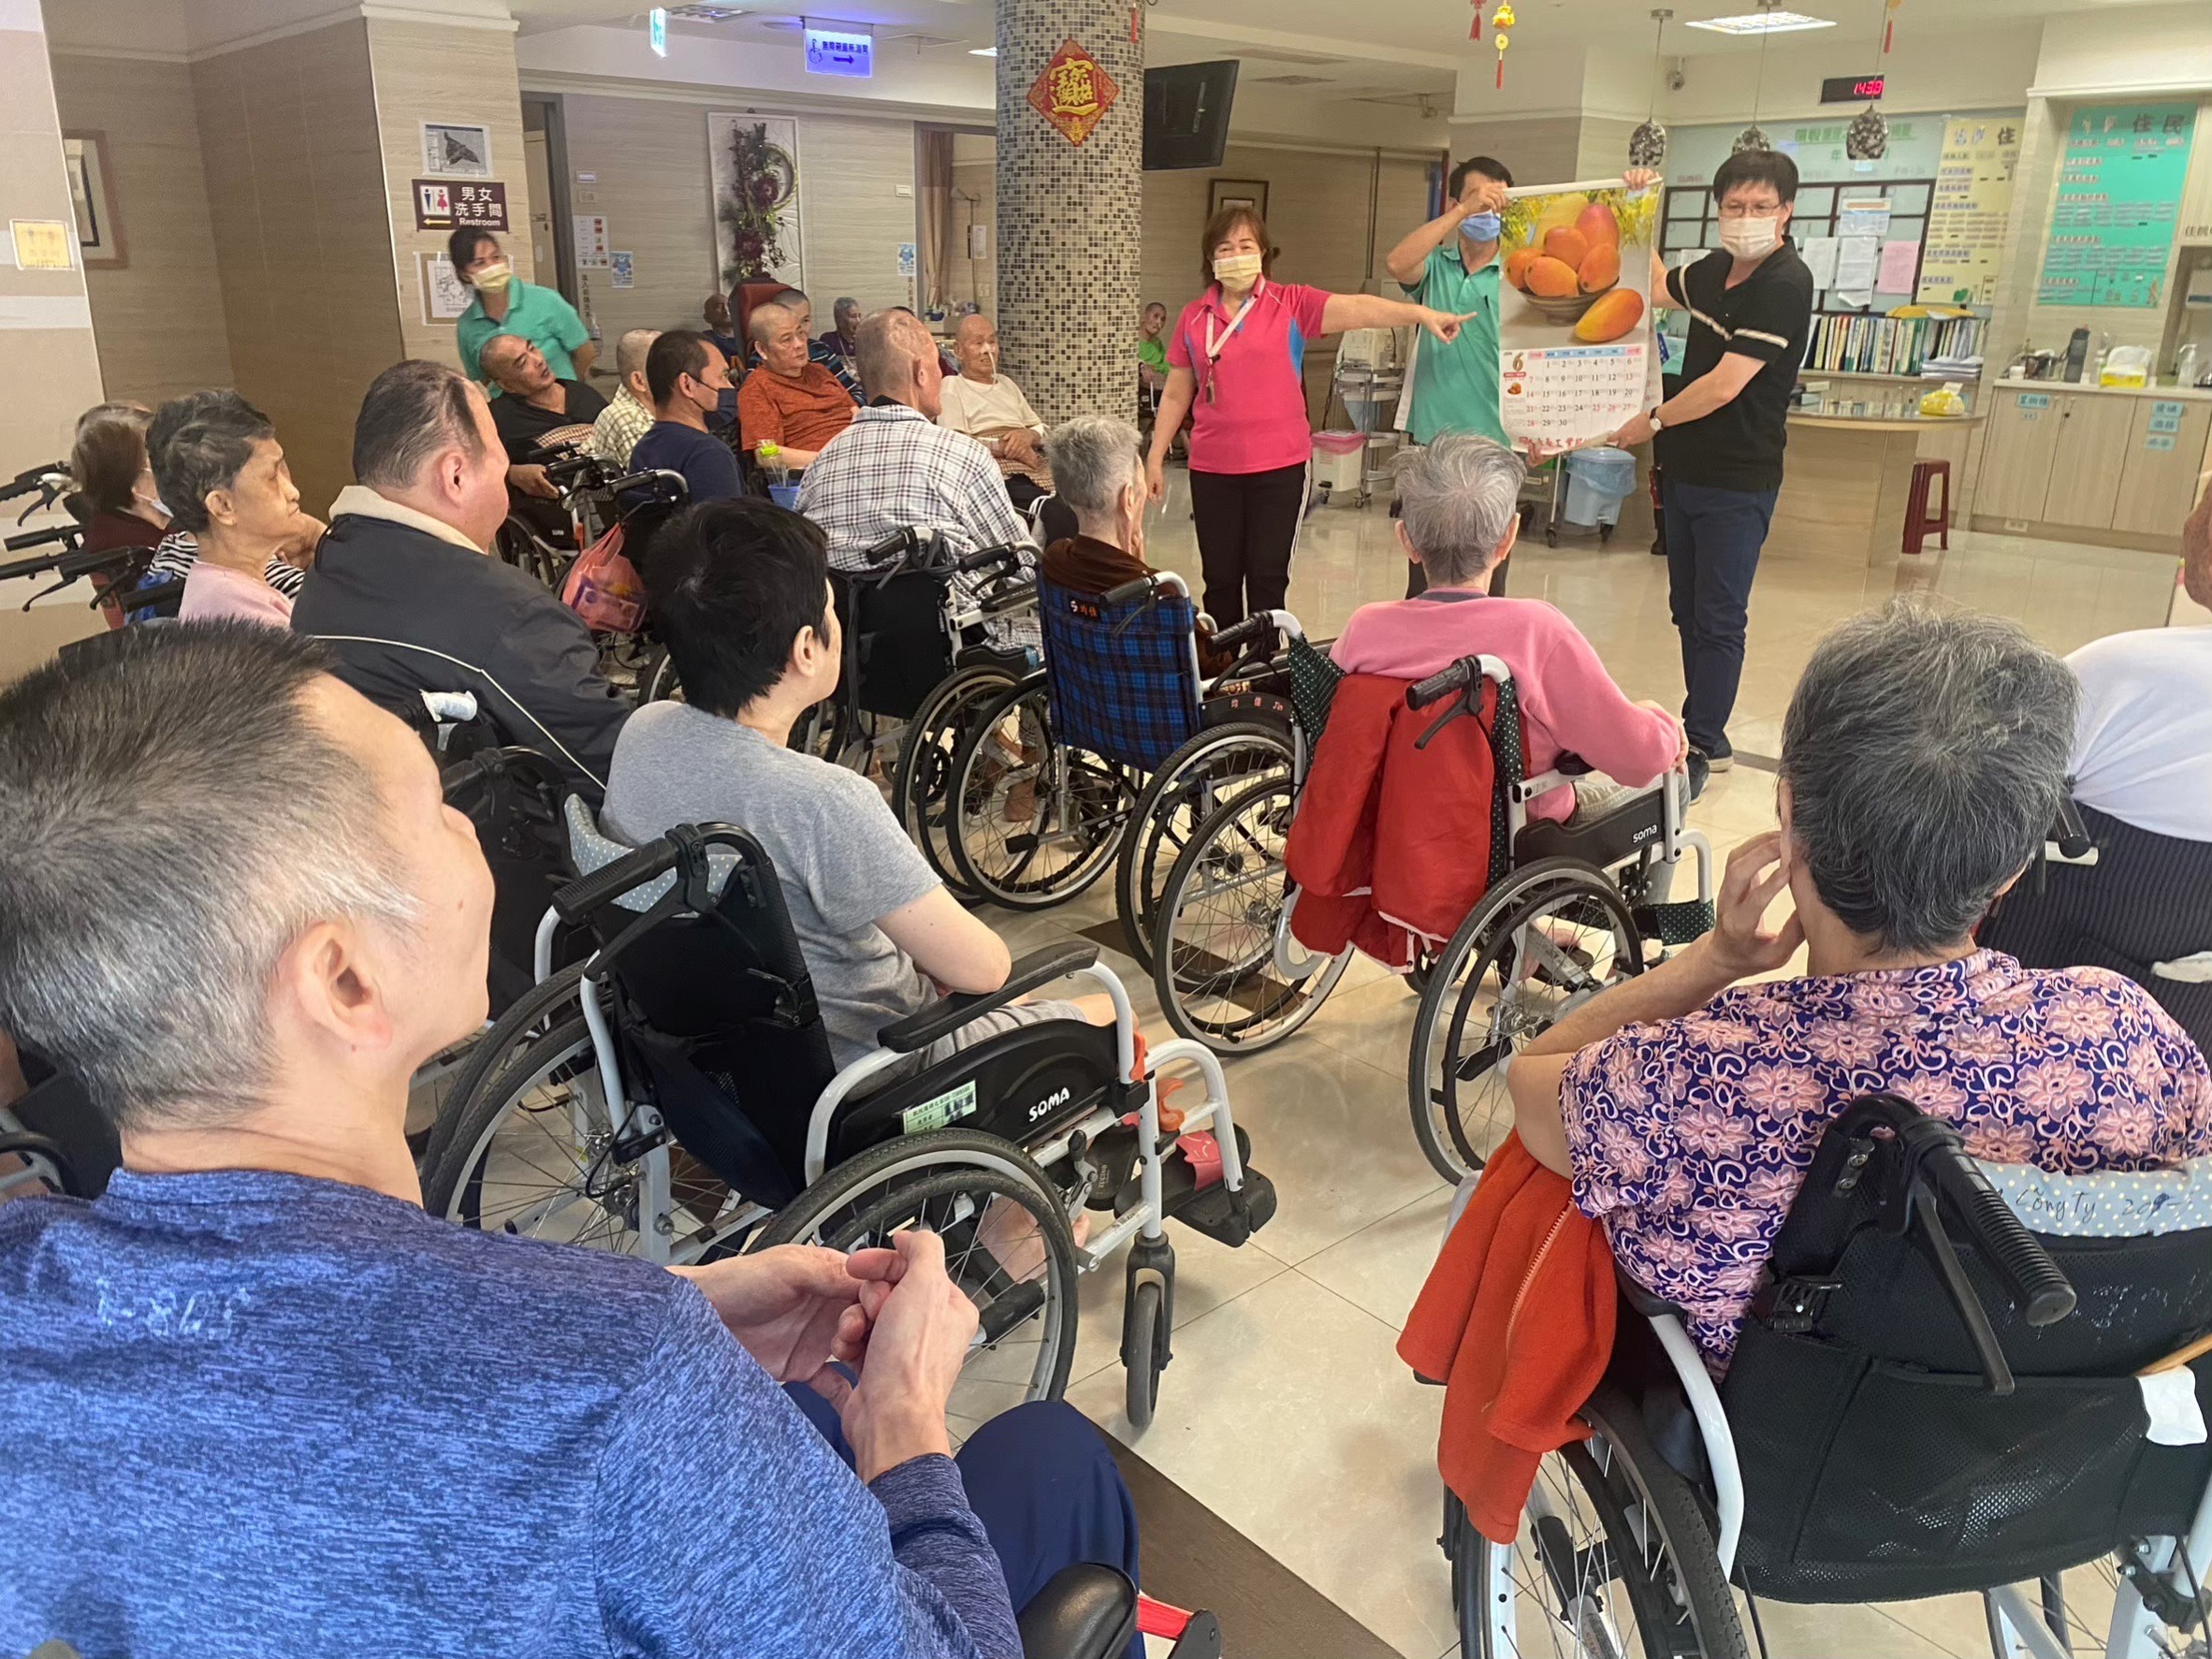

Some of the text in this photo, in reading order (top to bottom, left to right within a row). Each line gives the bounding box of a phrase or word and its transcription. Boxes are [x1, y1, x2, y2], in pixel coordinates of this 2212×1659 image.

[461, 186, 493, 202] 男女
[454, 202, 502, 217] 洗手間
[458, 218, 501, 226] Restroom
[1512, 352, 1524, 371] 6
[1029, 1086, 1070, 1122] SOMA
